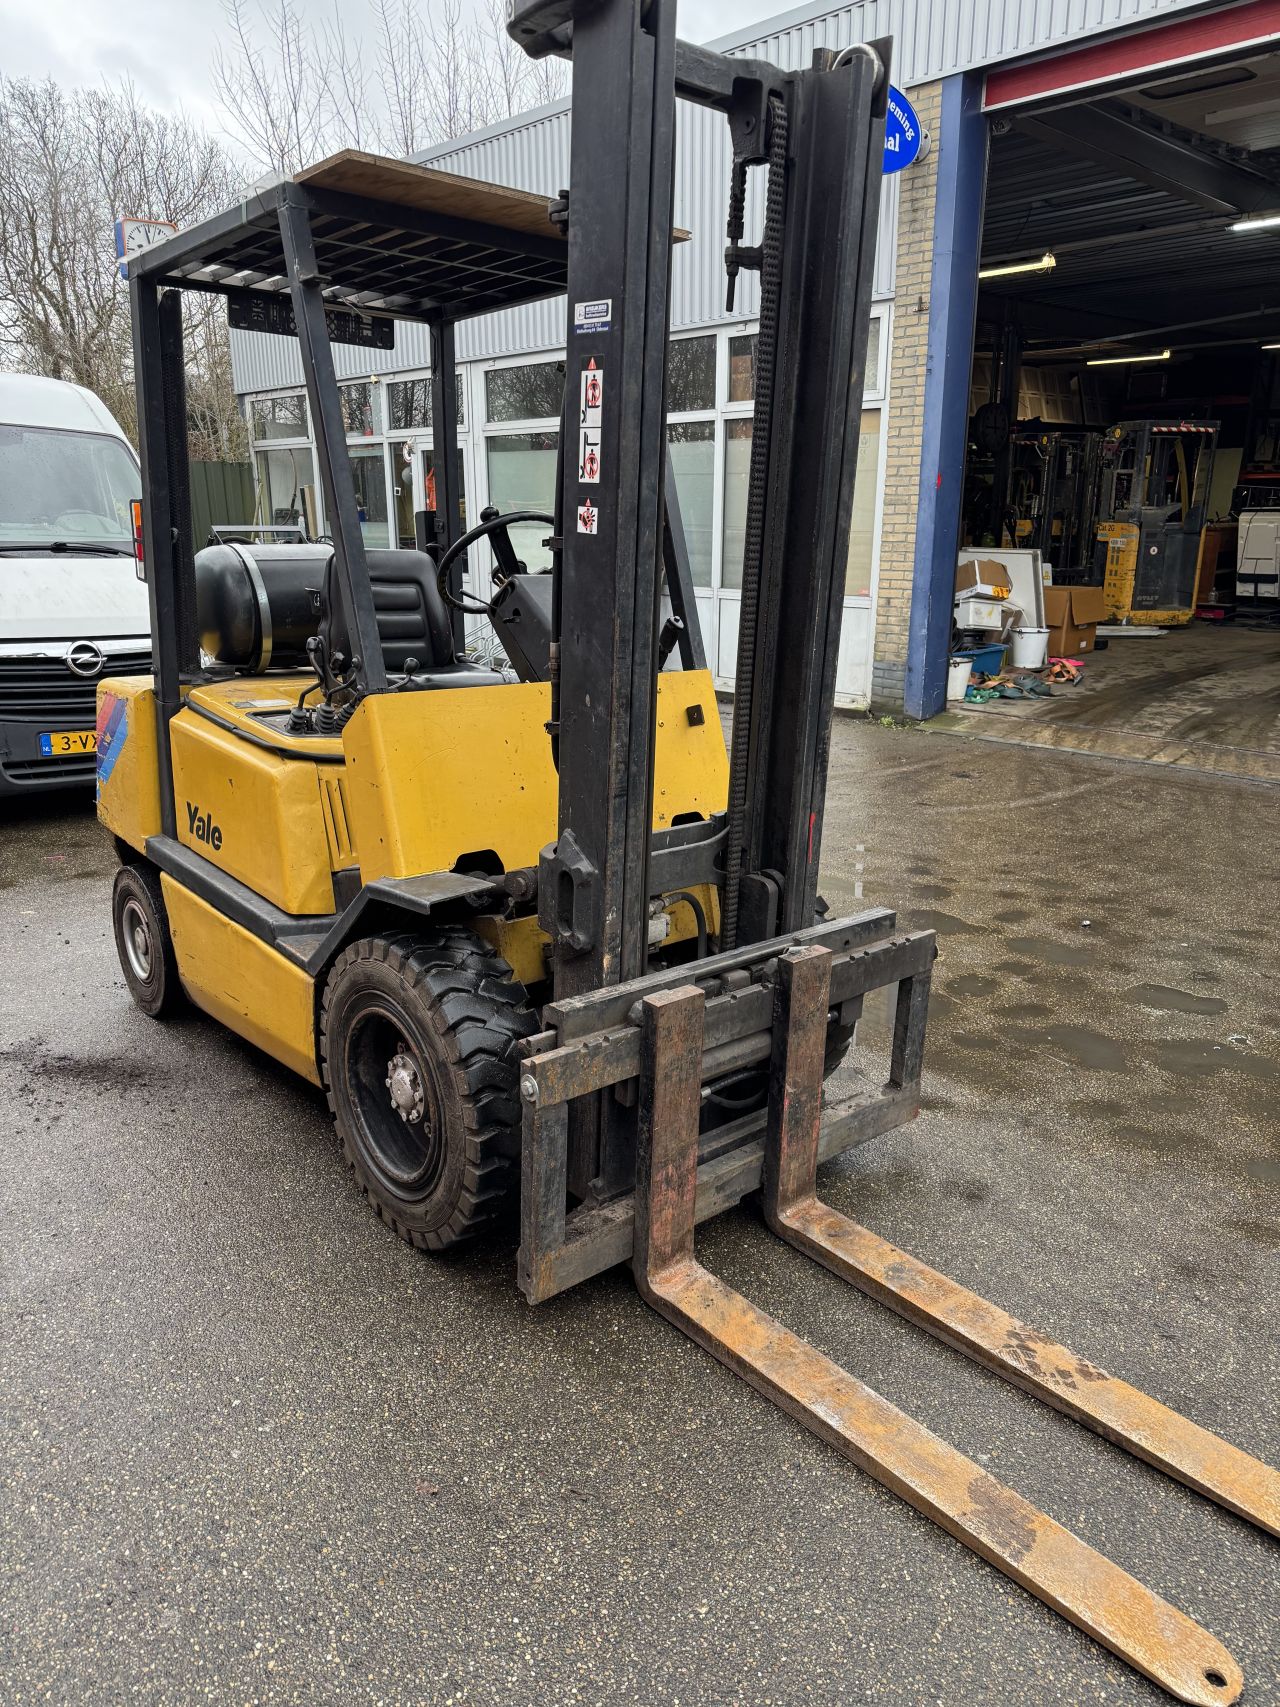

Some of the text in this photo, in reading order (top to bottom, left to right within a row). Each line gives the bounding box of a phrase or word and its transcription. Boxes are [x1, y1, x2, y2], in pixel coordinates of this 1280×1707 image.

[887, 98, 915, 141] eming
[884, 132, 900, 152] al
[186, 800, 222, 851] Yale
